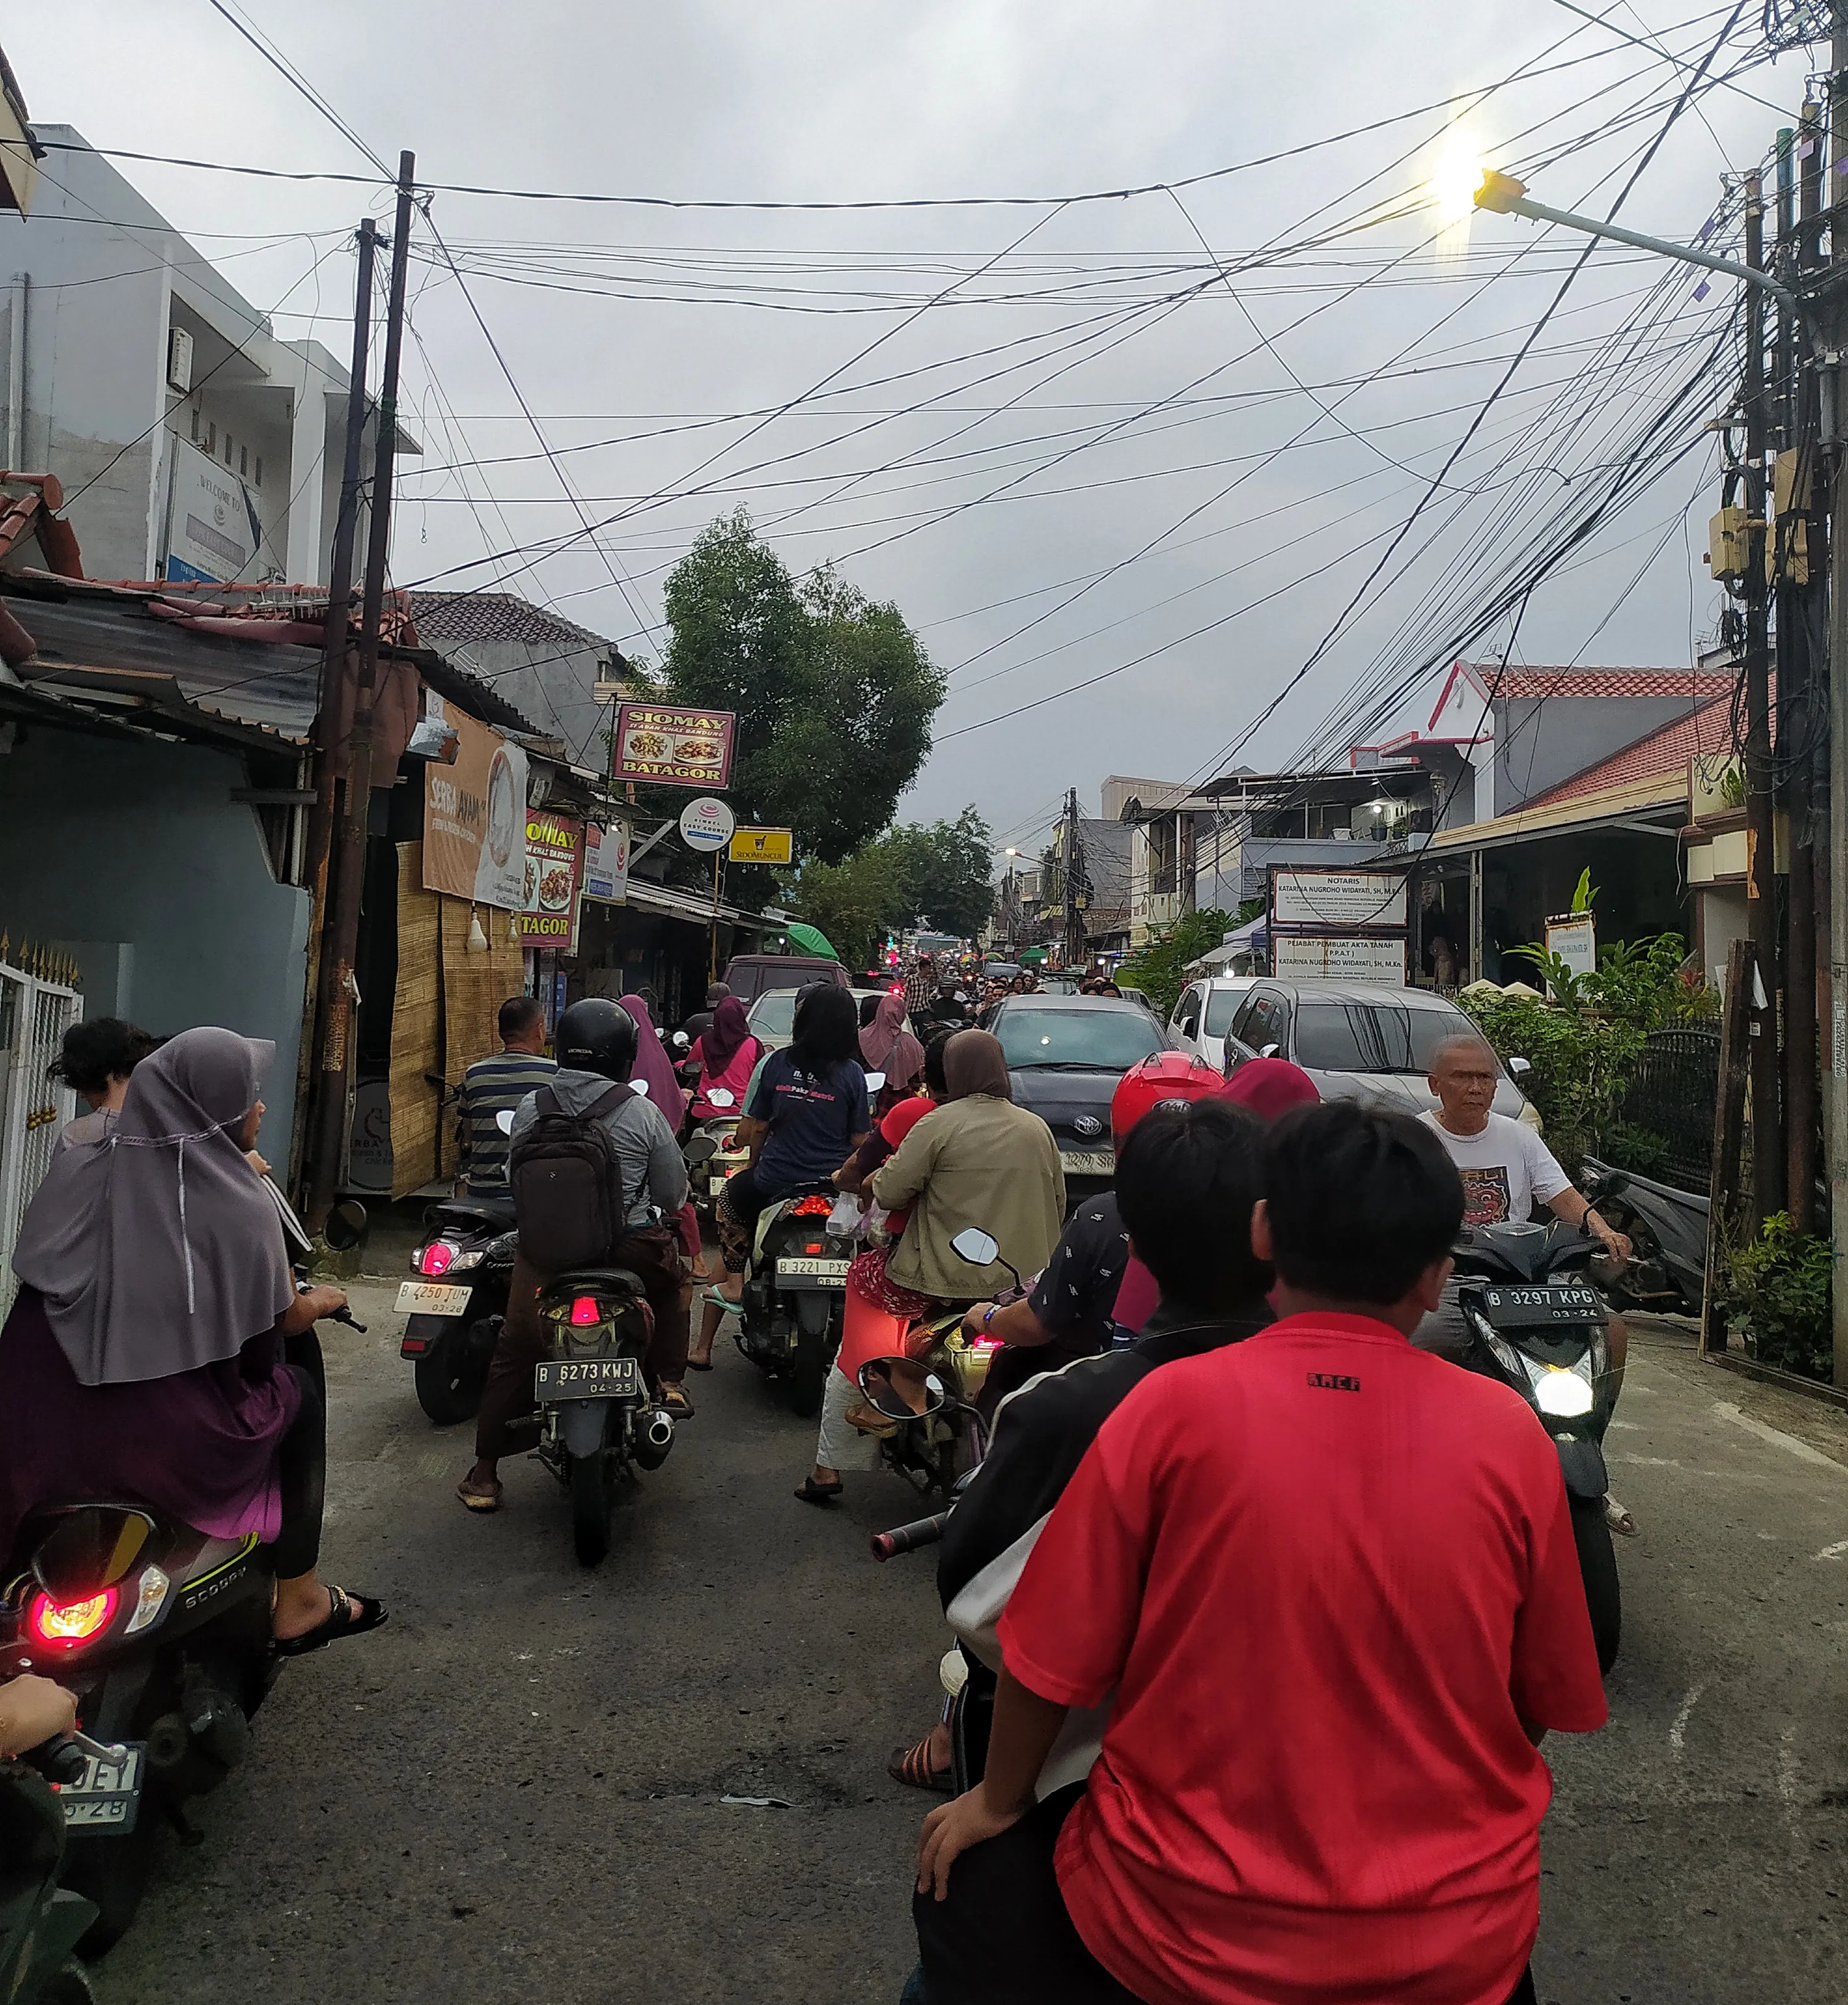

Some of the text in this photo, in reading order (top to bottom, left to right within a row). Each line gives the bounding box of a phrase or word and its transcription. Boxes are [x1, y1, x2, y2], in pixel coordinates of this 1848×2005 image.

[232, 496, 240, 512] TO
[627, 711, 727, 730] SIOMAY
[685, 729, 724, 737] BANDUNG
[622, 761, 721, 780] BATAGOR
[526, 822, 578, 849] OMAY
[703, 826, 730, 834] COURSE
[532, 844, 549, 856] KHAS
[1278, 885, 1308, 893] KATARINA
[1342, 886, 1372, 895] WIDAYATI,
[521, 916, 569, 935] TAGOR
[1342, 960, 1373, 968] WIDAYATI,
[780, 1262, 850, 1274] B 3221 PXS
[400, 1284, 470, 1301] B 4250 TUM
[1491, 1290, 1594, 1306] B 3297 KPG
[539, 1363, 633, 1382] B 6273 KWJ
